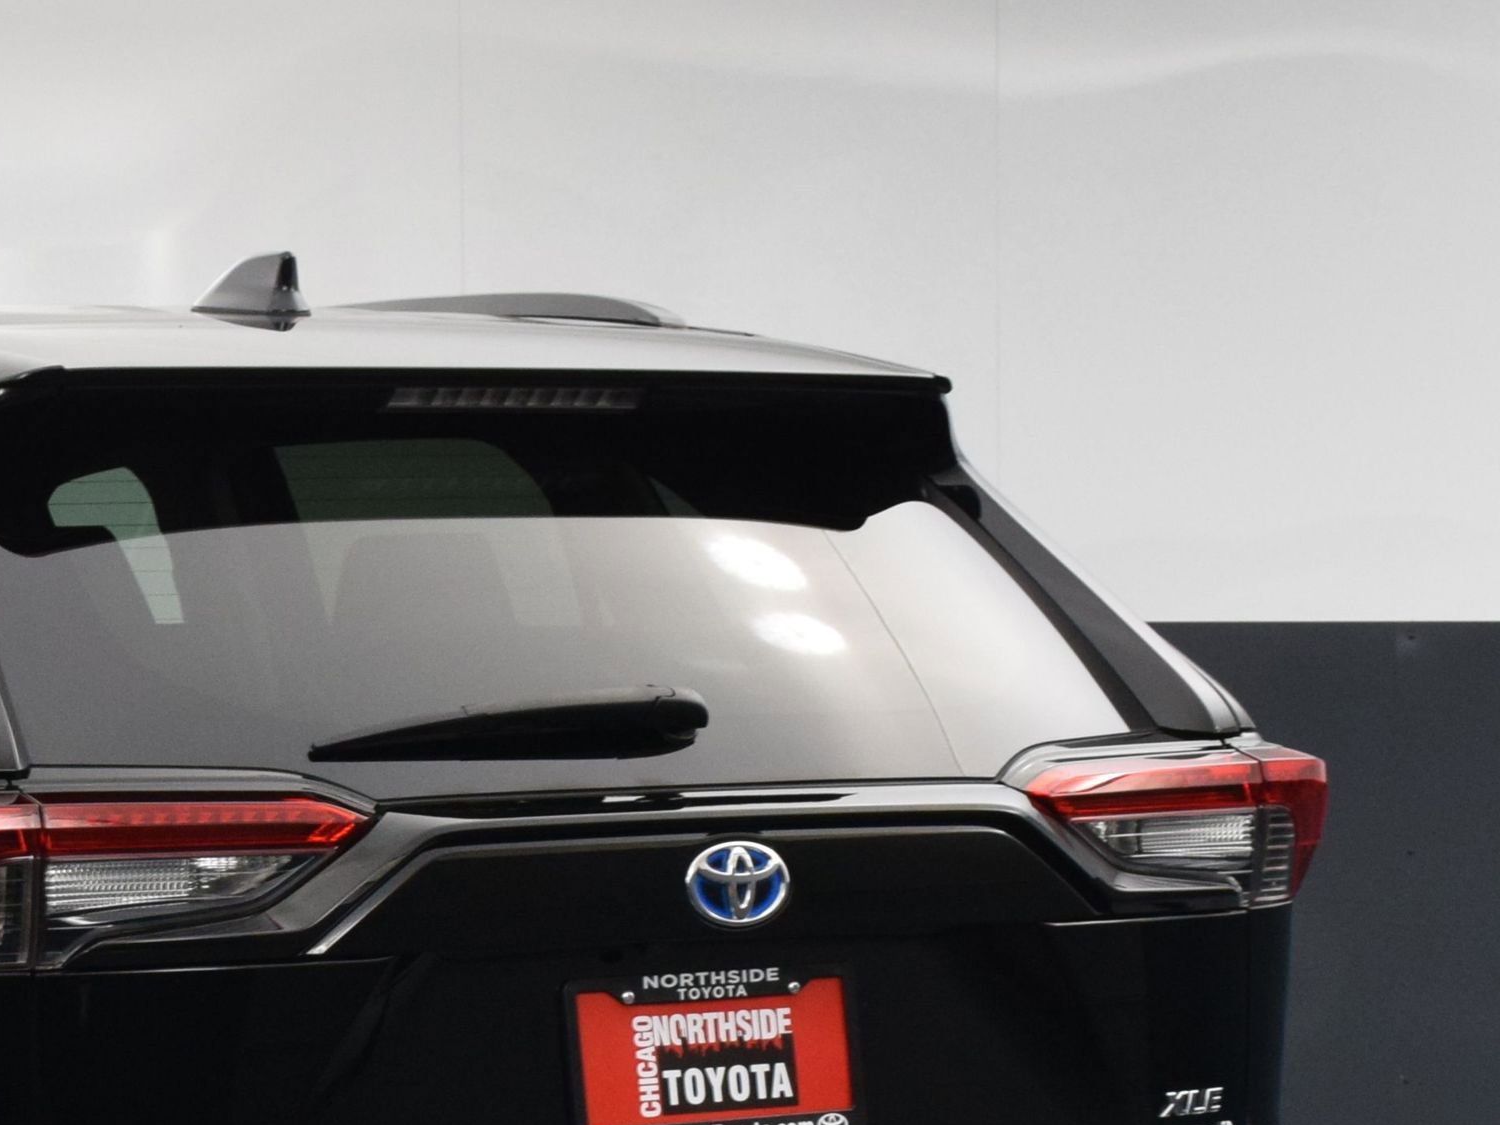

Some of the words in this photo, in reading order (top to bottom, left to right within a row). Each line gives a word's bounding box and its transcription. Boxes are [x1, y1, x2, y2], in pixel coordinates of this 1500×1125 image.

[642, 967, 780, 990] NORTHSIDE
[677, 984, 748, 1001] TOYOTA
[651, 1007, 793, 1047] NORTHSIDE
[631, 1015, 663, 1119] CHICAGO
[662, 1062, 794, 1106] TOYOTA
[1159, 1087, 1224, 1118] XLE
